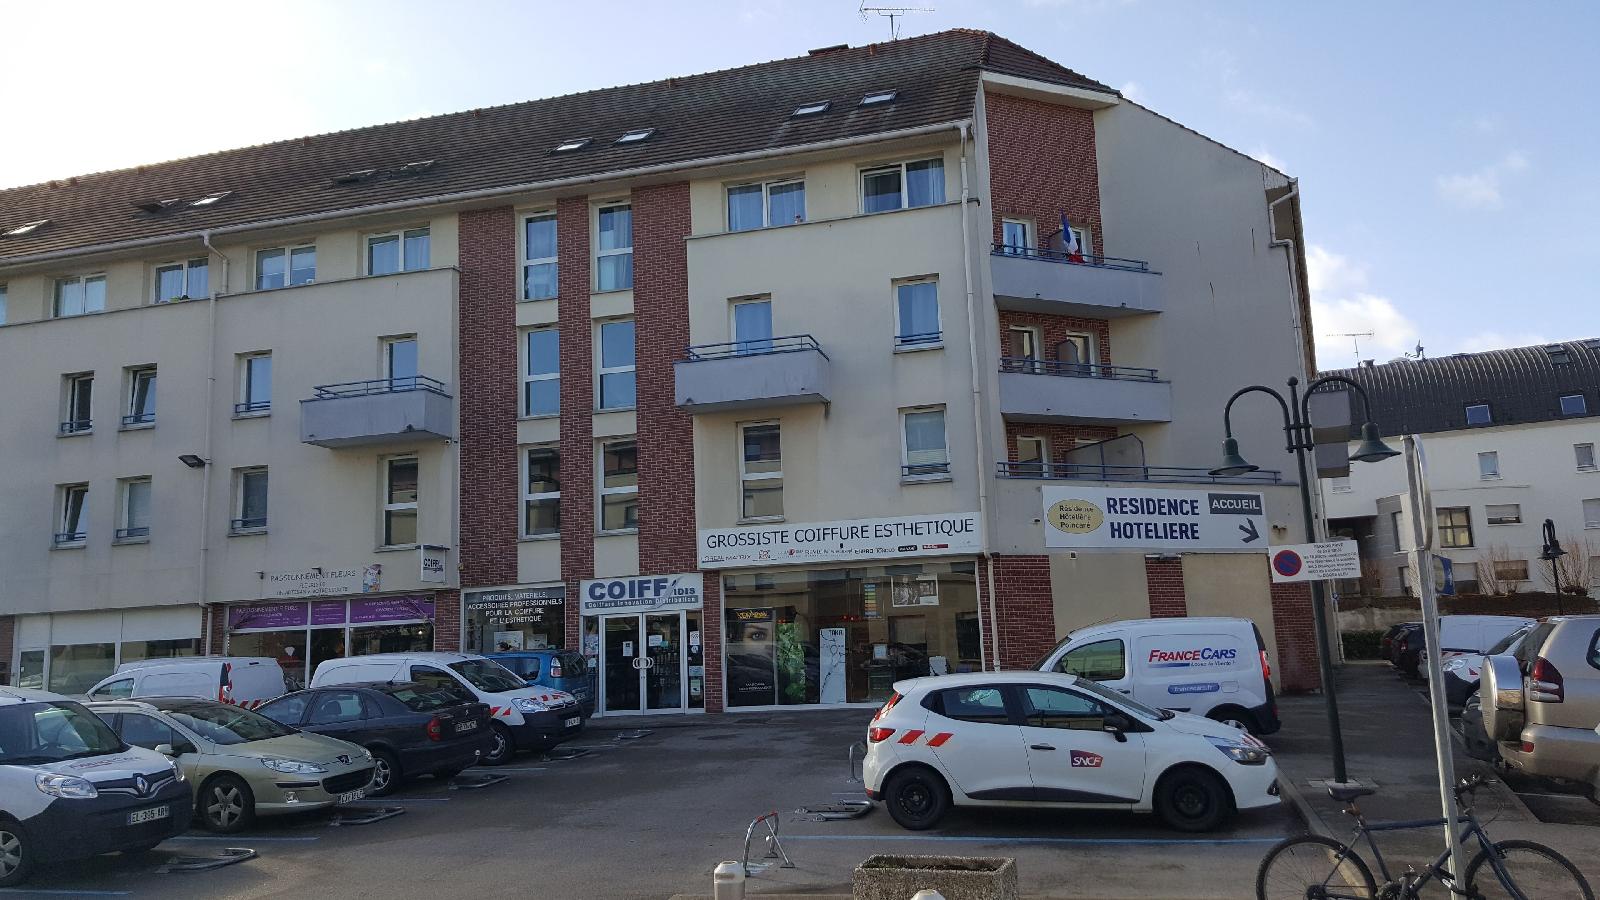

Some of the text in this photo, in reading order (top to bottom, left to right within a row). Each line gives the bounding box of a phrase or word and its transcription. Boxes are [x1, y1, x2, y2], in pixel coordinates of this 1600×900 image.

[1106, 497, 1260, 516] RESIDENCE ACCUEIL
[1060, 521, 1091, 529] Poincaré
[1110, 521, 1200, 540] HOTELIERE
[706, 518, 974, 548] GROSSISTE COIFFURE ESTHETIQUE
[330, 570, 356, 579] FLEURS
[468, 598, 563, 610] ACCESSOIRES PROFESSIONNELS
[588, 601, 615, 609] Coiffure
[655, 596, 696, 604] Distribution
[485, 609, 503, 617] POUR
[1072, 756, 1102, 766] SNCF
